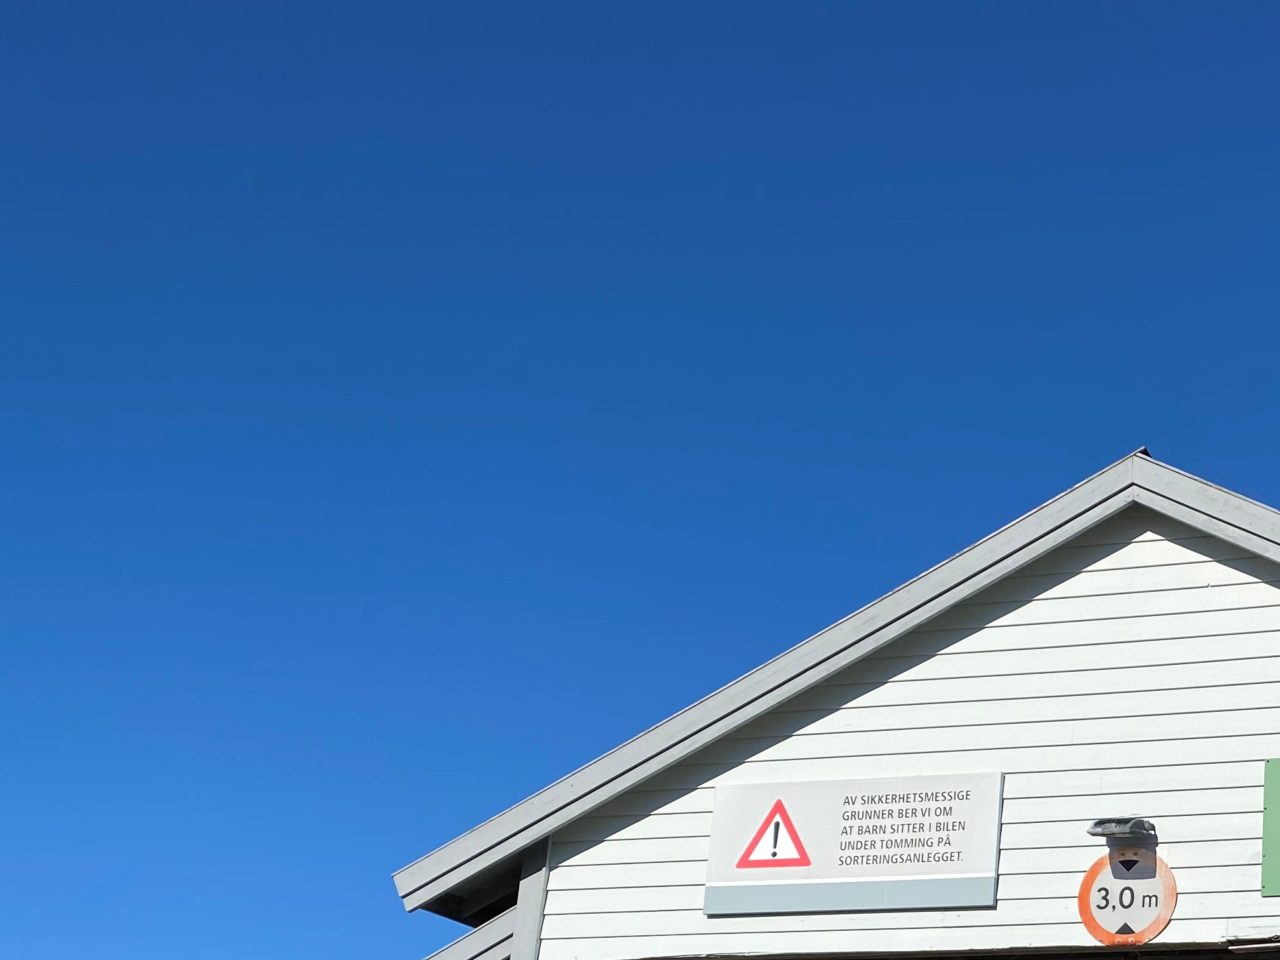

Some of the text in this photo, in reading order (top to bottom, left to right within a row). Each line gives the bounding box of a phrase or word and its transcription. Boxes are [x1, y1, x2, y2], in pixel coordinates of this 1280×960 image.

[843, 790, 971, 806] AV SIKKERHETSMESSIGE
[842, 806, 953, 821] GRUNNER BER VI OM
[841, 820, 966, 836] AT BARN SITTER I BILEN
[839, 834, 952, 851] UNDER TØMMING PÅ
[838, 851, 964, 866] SORTERINGSANLEGGET.
[1096, 886, 1158, 912] 3,0 m
